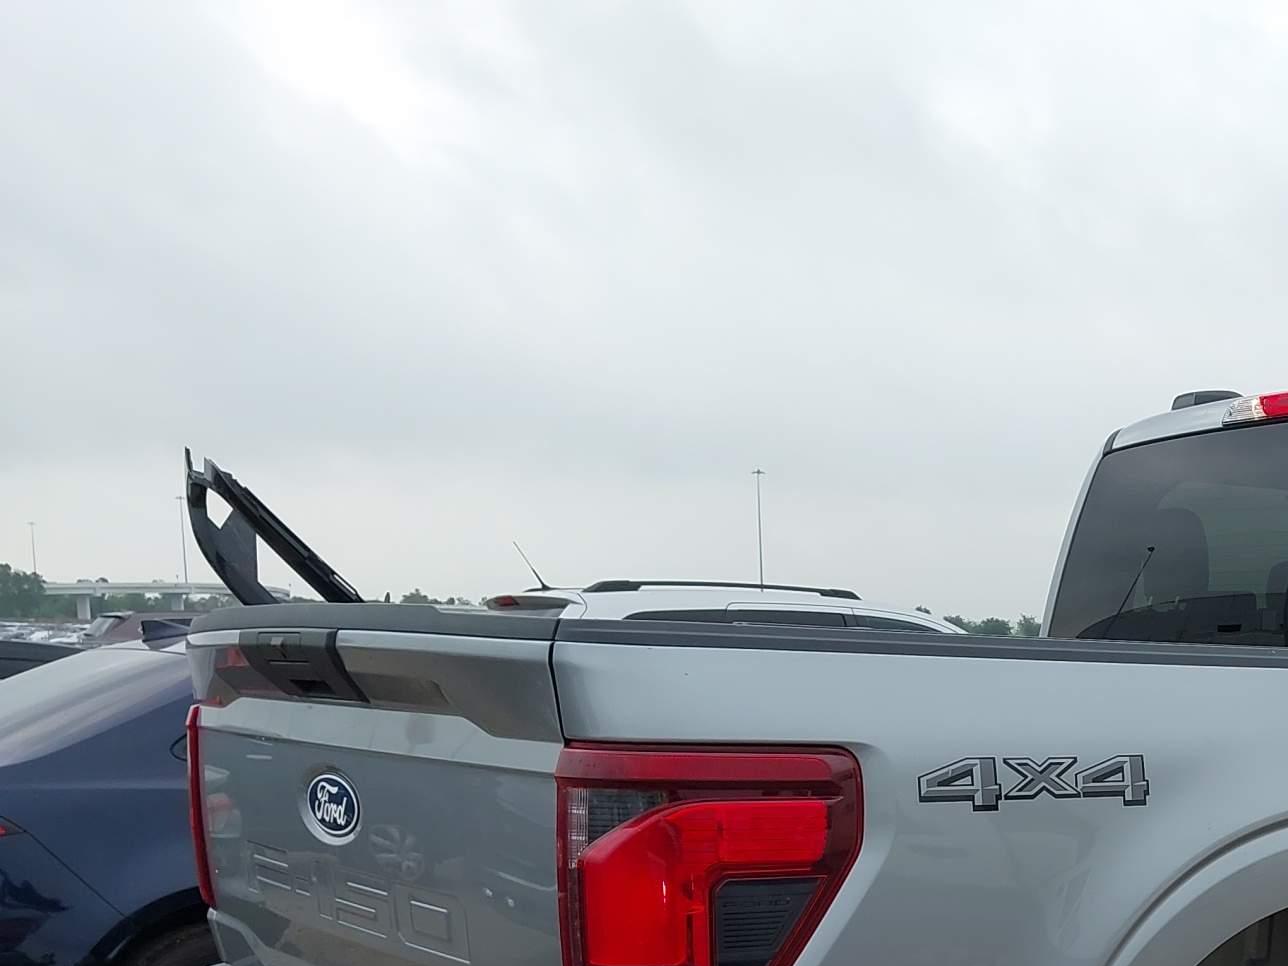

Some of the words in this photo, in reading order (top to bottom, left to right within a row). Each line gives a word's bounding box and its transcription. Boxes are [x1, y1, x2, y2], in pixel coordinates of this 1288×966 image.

[314, 781, 348, 826] Ford
[917, 754, 1150, 812] 4X4
[247, 839, 471, 965] F-150
